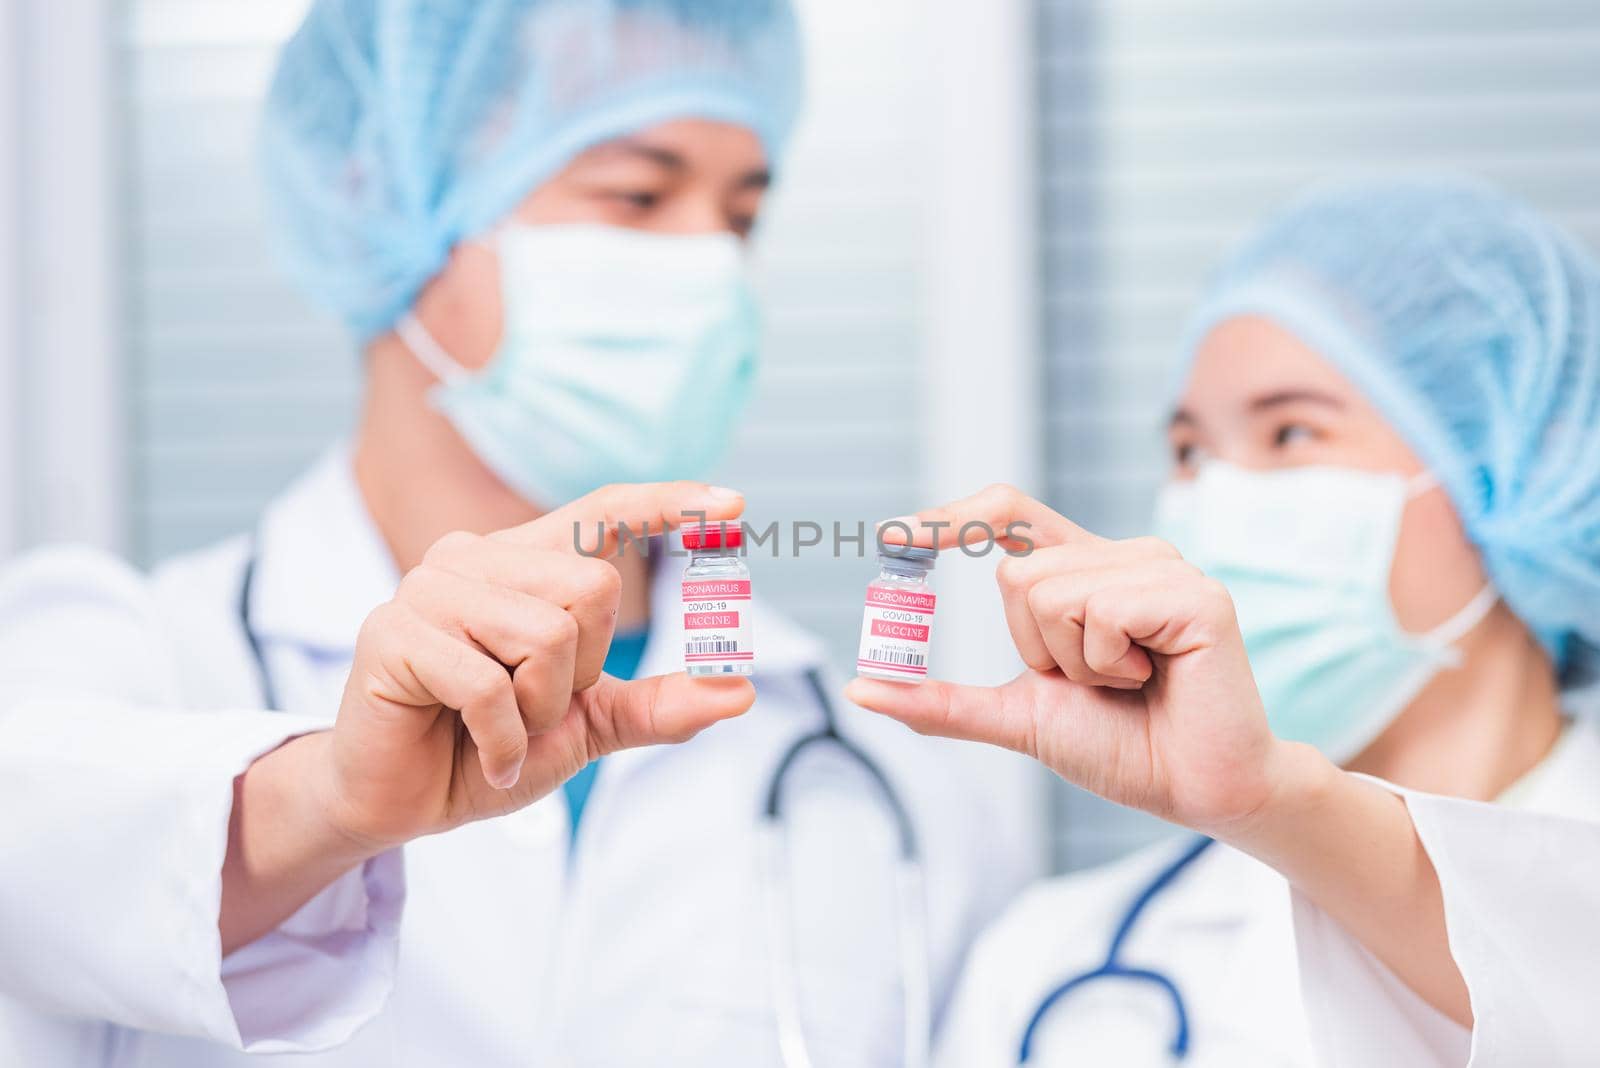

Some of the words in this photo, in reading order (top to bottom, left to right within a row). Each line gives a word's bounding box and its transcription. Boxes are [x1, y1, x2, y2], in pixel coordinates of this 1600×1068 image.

[688, 602, 727, 611] COVID-19
[688, 615, 731, 625] VACCINE
[883, 611, 923, 623] COVID-19
[879, 624, 924, 638] VACCINE
